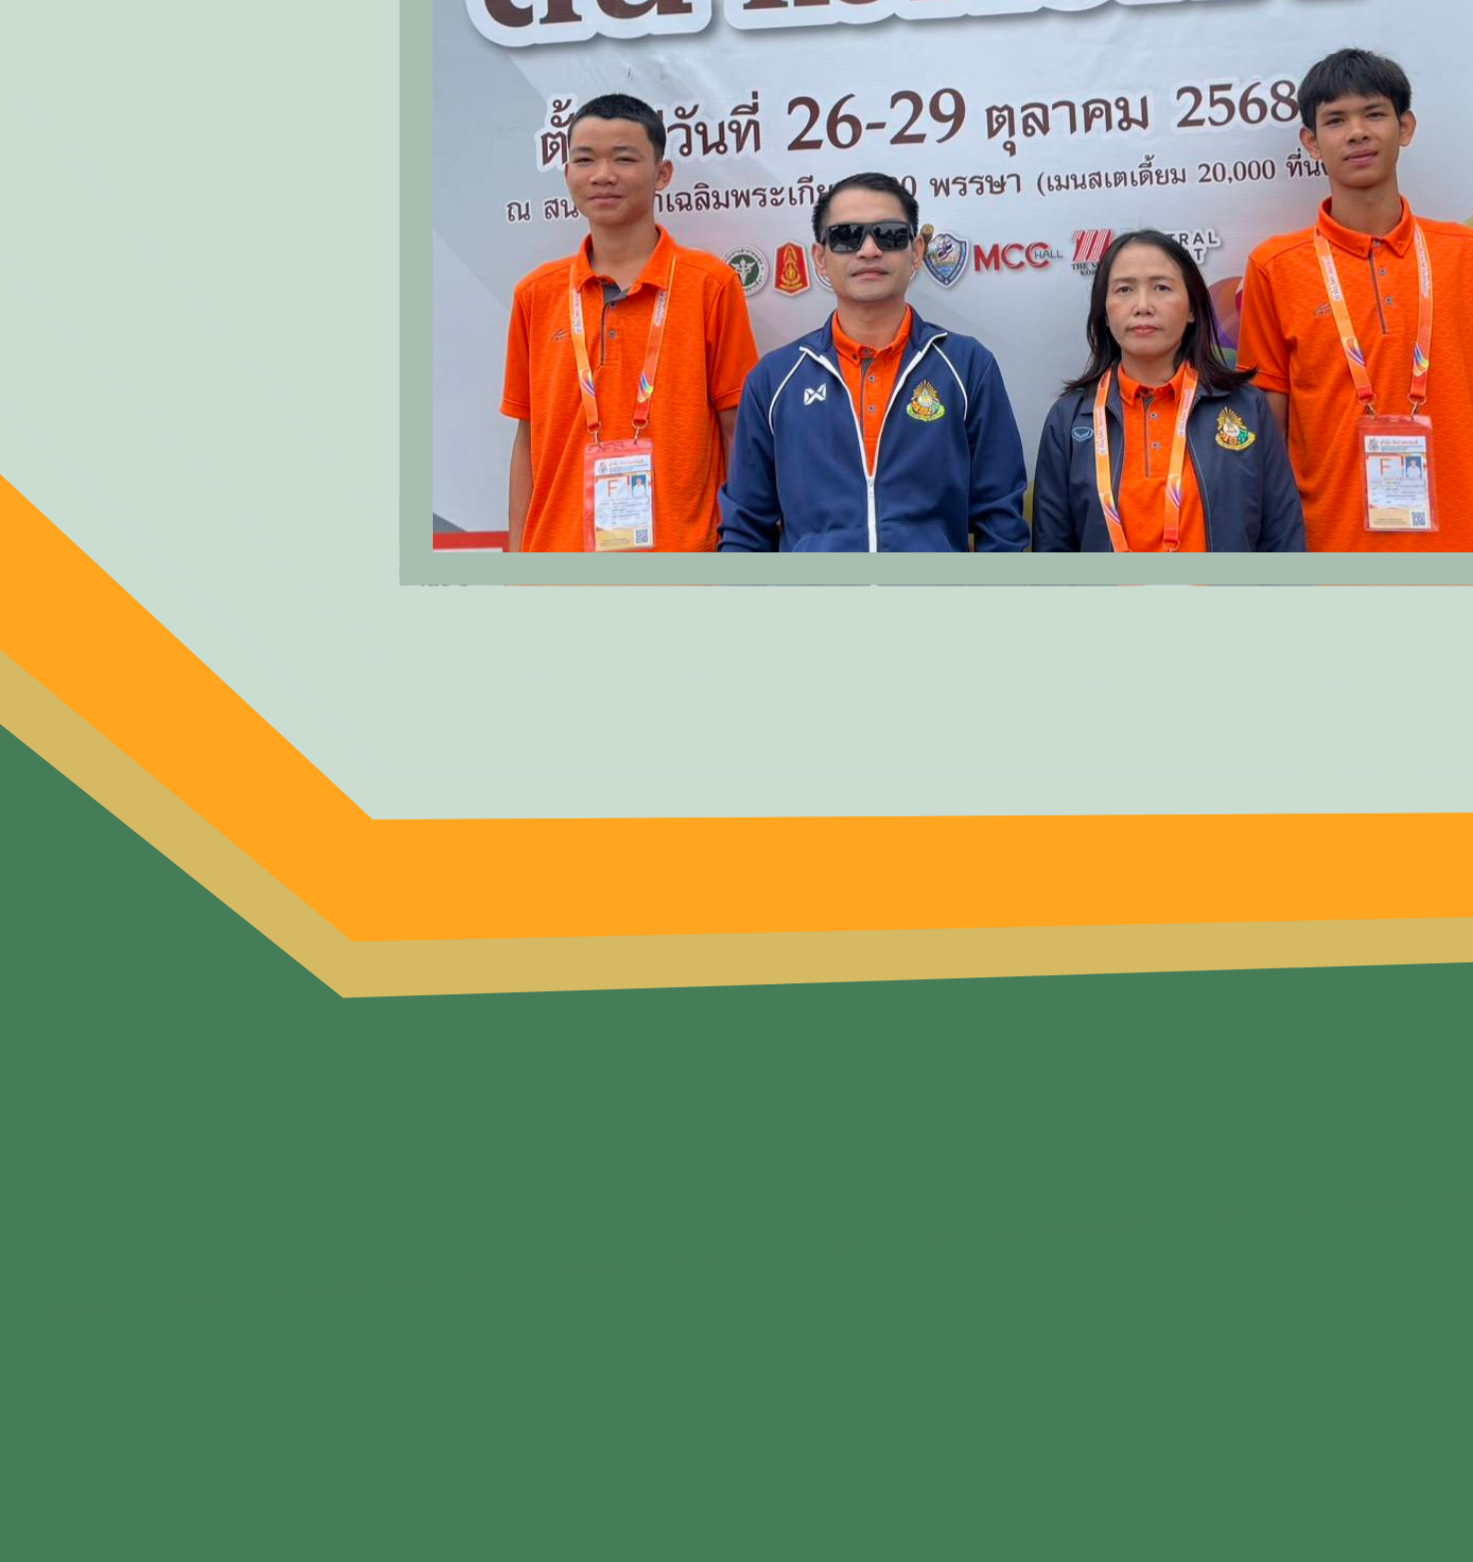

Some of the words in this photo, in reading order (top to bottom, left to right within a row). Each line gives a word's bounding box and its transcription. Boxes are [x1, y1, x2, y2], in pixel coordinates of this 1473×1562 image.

[787, 87, 967, 153] 26-29
[985, 94, 1150, 157] ตุลาคม
[1176, 80, 1299, 129] 2568
[507, 200, 531, 222] ณ
[929, 171, 1022, 198] พรรษา
[1198, 158, 1277, 186] 20,000
[973, 241, 1051, 272] MCC
[1034, 249, 1064, 260] HALL
